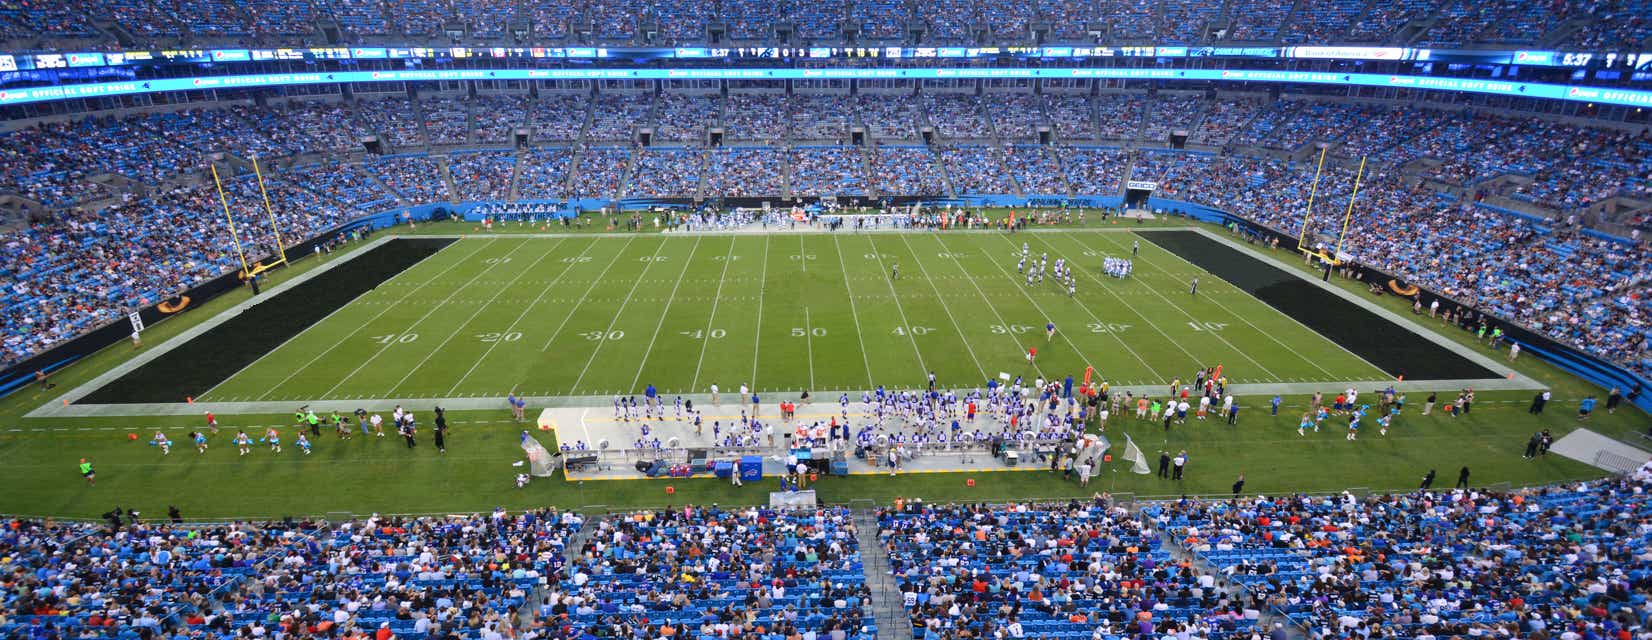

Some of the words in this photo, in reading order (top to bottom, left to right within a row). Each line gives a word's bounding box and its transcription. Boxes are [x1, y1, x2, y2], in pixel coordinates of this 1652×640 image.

[791, 327, 827, 337] 50
[889, 326, 927, 336] 40
[990, 324, 1027, 335] 30
[1087, 323, 1126, 333] 20
[1188, 322, 1222, 332] 10
[375, 333, 418, 344] 10
[480, 332, 522, 342] 20
[586, 330, 624, 340] 30
[689, 328, 726, 339] 40
